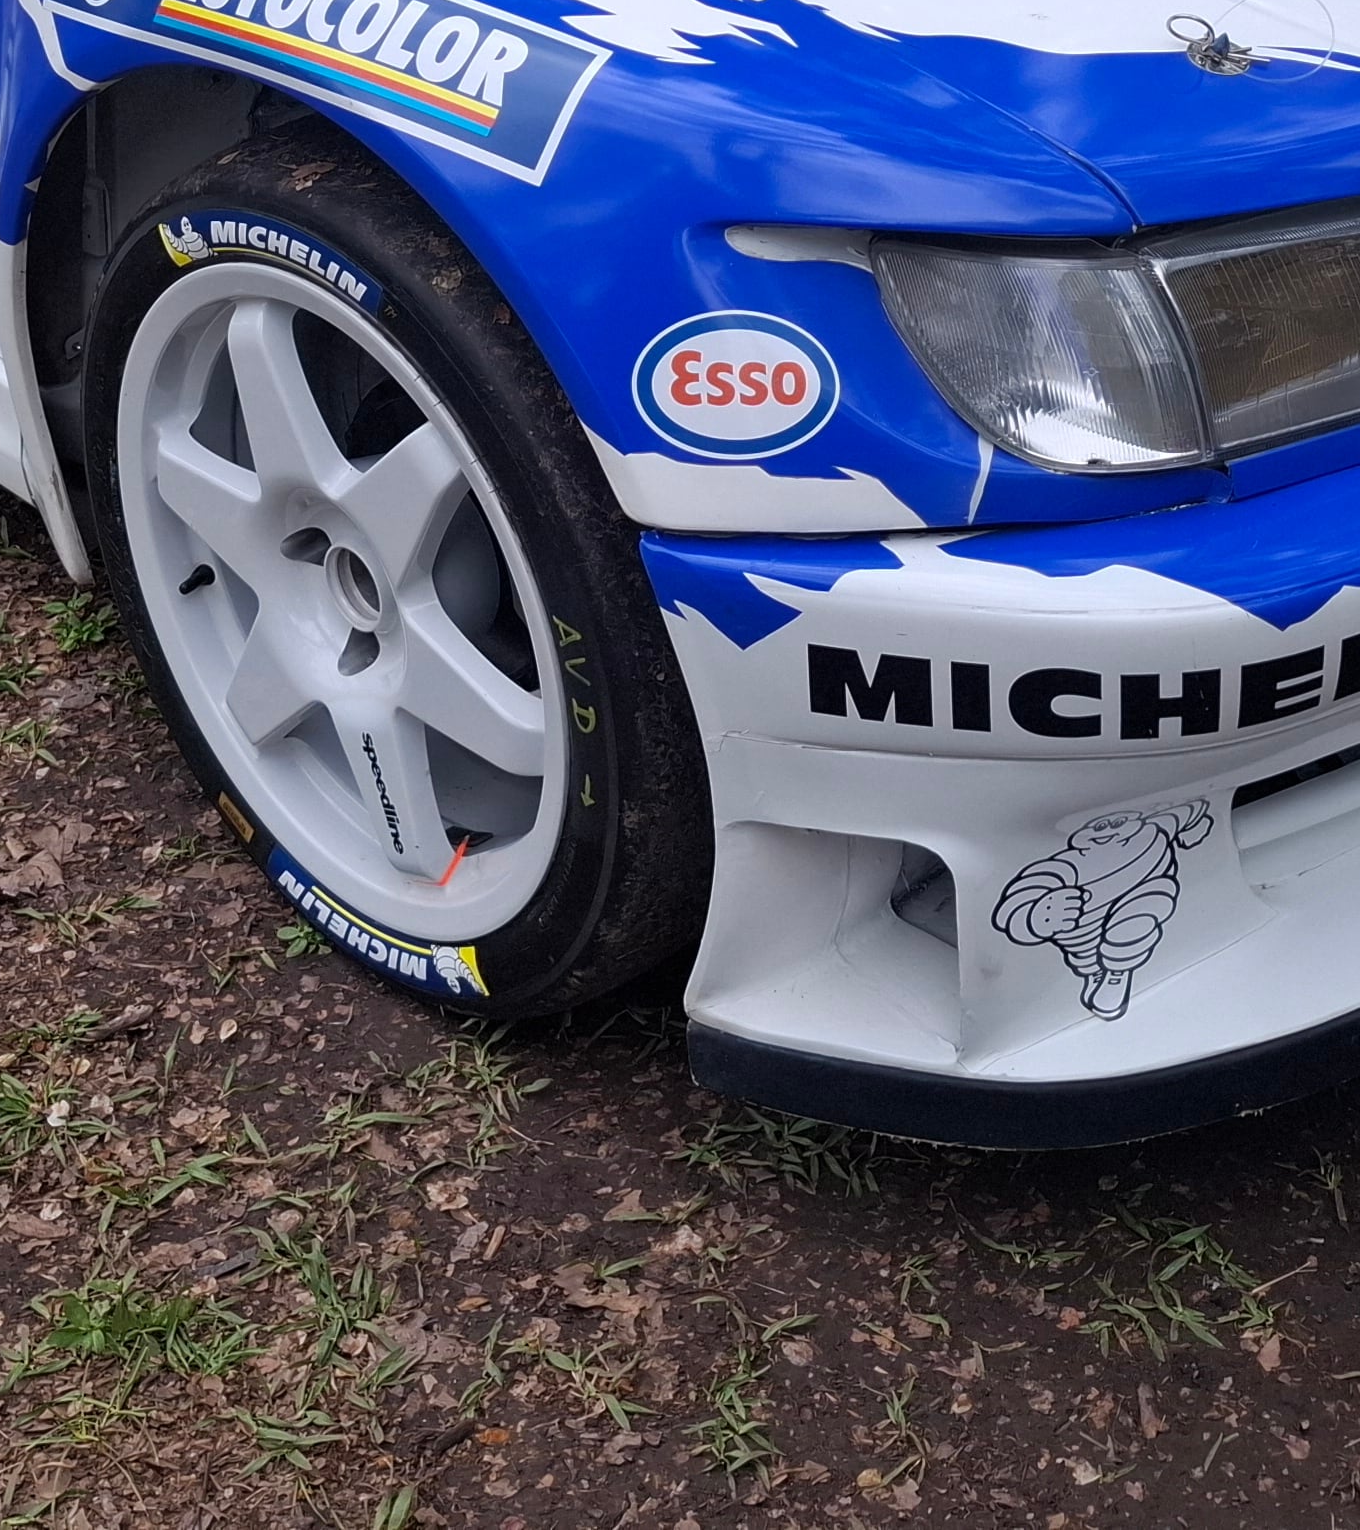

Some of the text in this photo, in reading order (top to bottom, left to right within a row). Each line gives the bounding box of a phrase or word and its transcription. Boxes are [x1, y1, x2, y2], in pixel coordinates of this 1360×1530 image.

[210, 220, 368, 303] MICHELIN
[362, 731, 404, 856] speedline
[278, 870, 428, 981] MICHELIN
